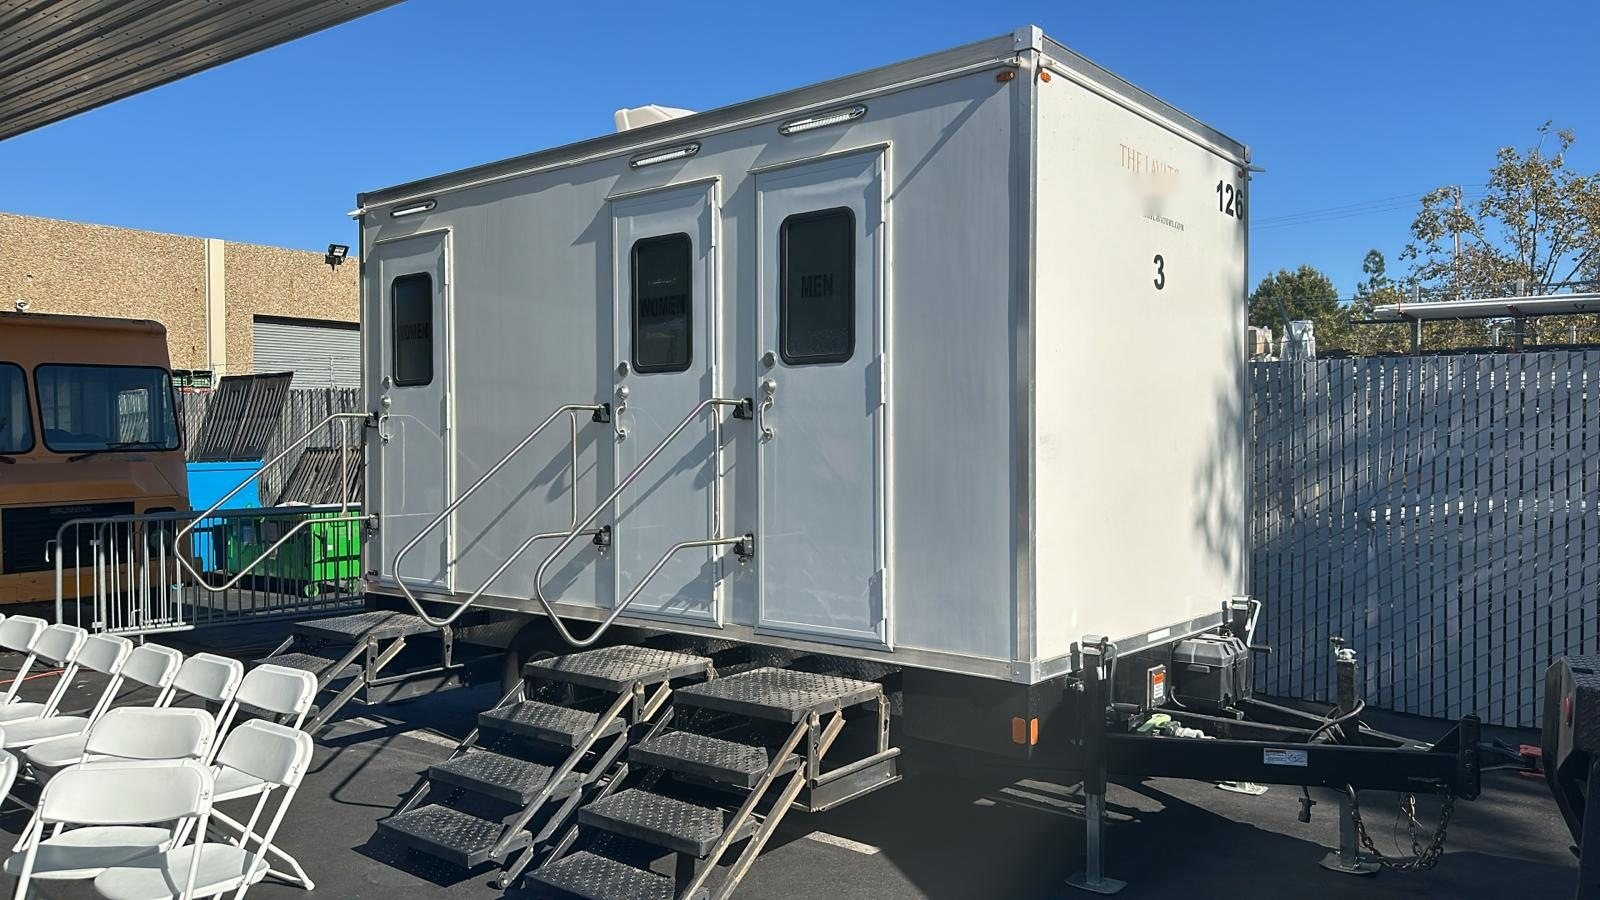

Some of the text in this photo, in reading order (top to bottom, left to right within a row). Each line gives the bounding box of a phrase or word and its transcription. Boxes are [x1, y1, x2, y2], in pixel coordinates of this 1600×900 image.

[1216, 180, 1243, 220] 126
[801, 273, 833, 298] MEN
[1153, 254, 1165, 290] 3
[640, 293, 686, 318] WOMEN
